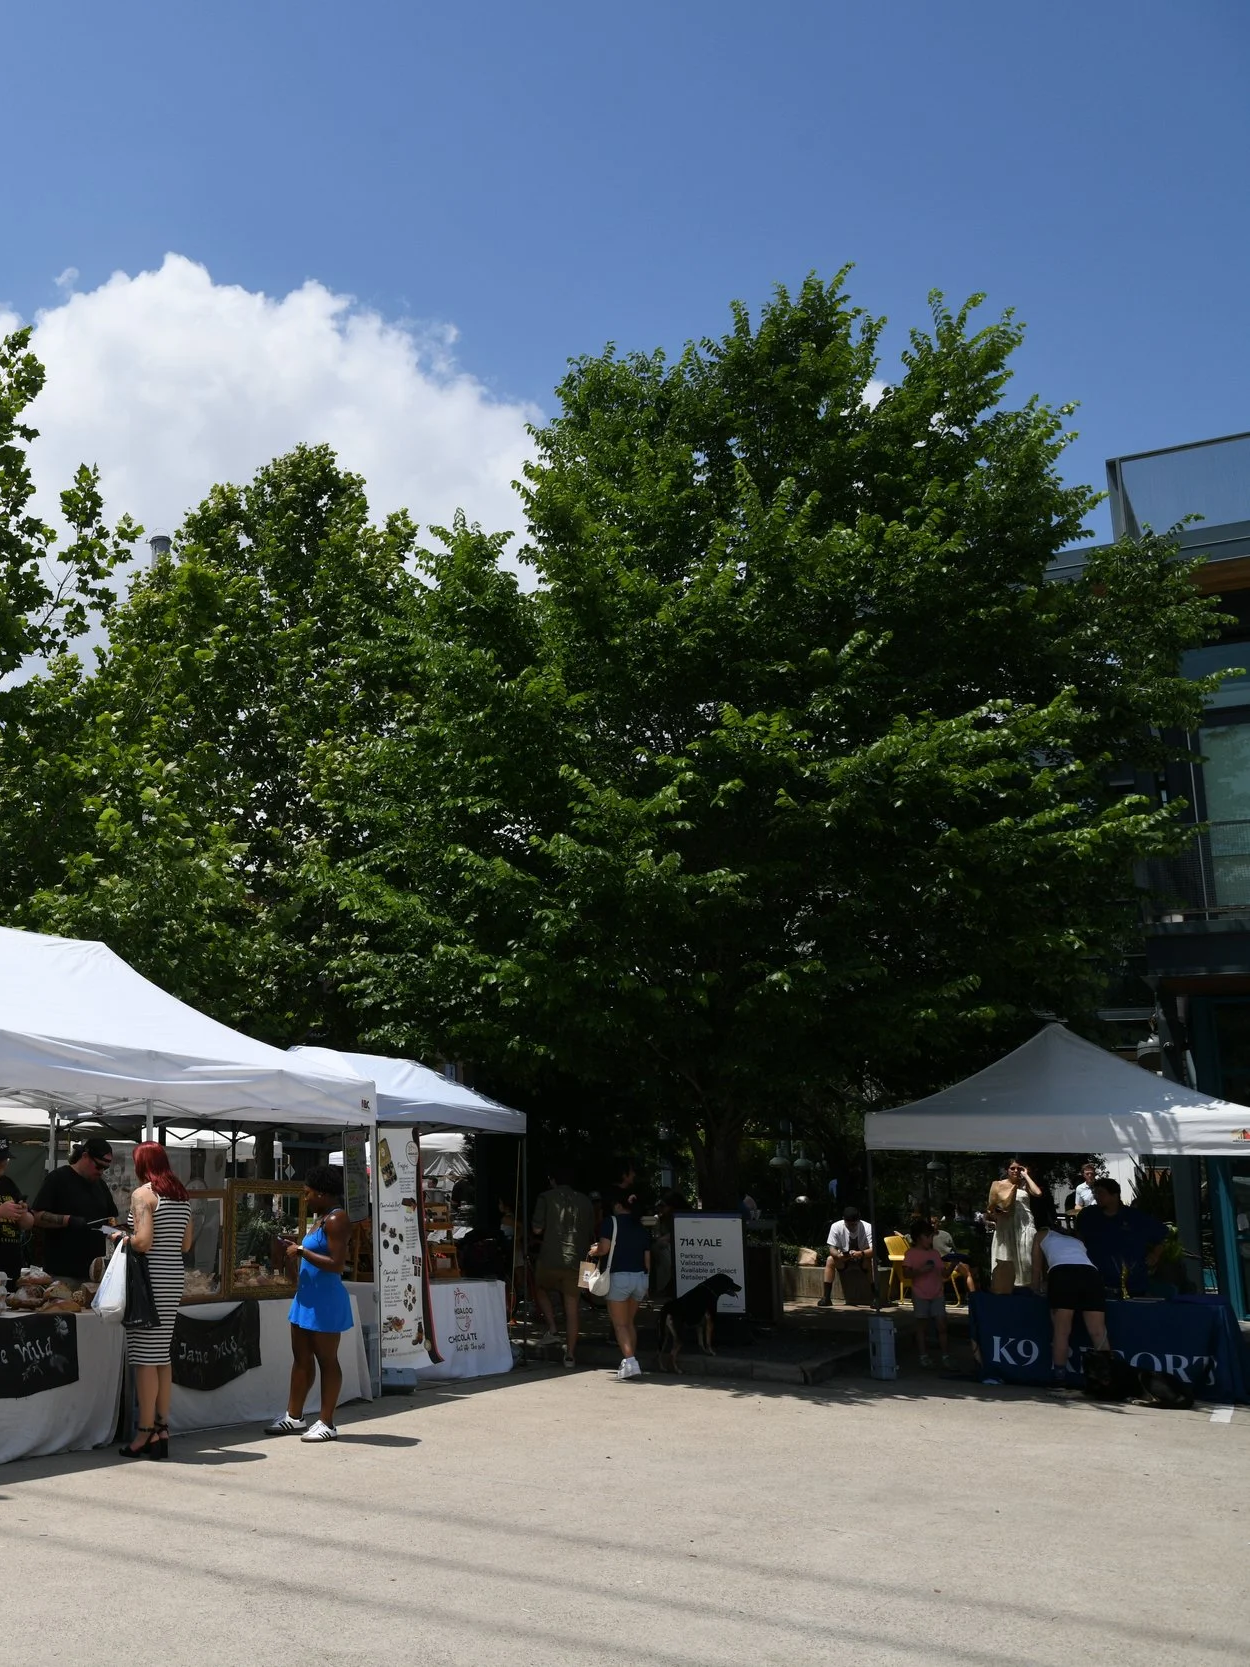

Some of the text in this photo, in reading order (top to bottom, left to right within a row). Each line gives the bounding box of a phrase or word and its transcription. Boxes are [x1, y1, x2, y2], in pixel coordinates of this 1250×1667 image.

[680, 1238, 722, 1247] 714 YALE
[680, 1252, 703, 1260] Parking
[717, 1267, 737, 1275] Select
[14, 1336, 53, 1363] Wild
[179, 1342, 209, 1364] Jane
[992, 1335, 1218, 1386] K9 RORT
